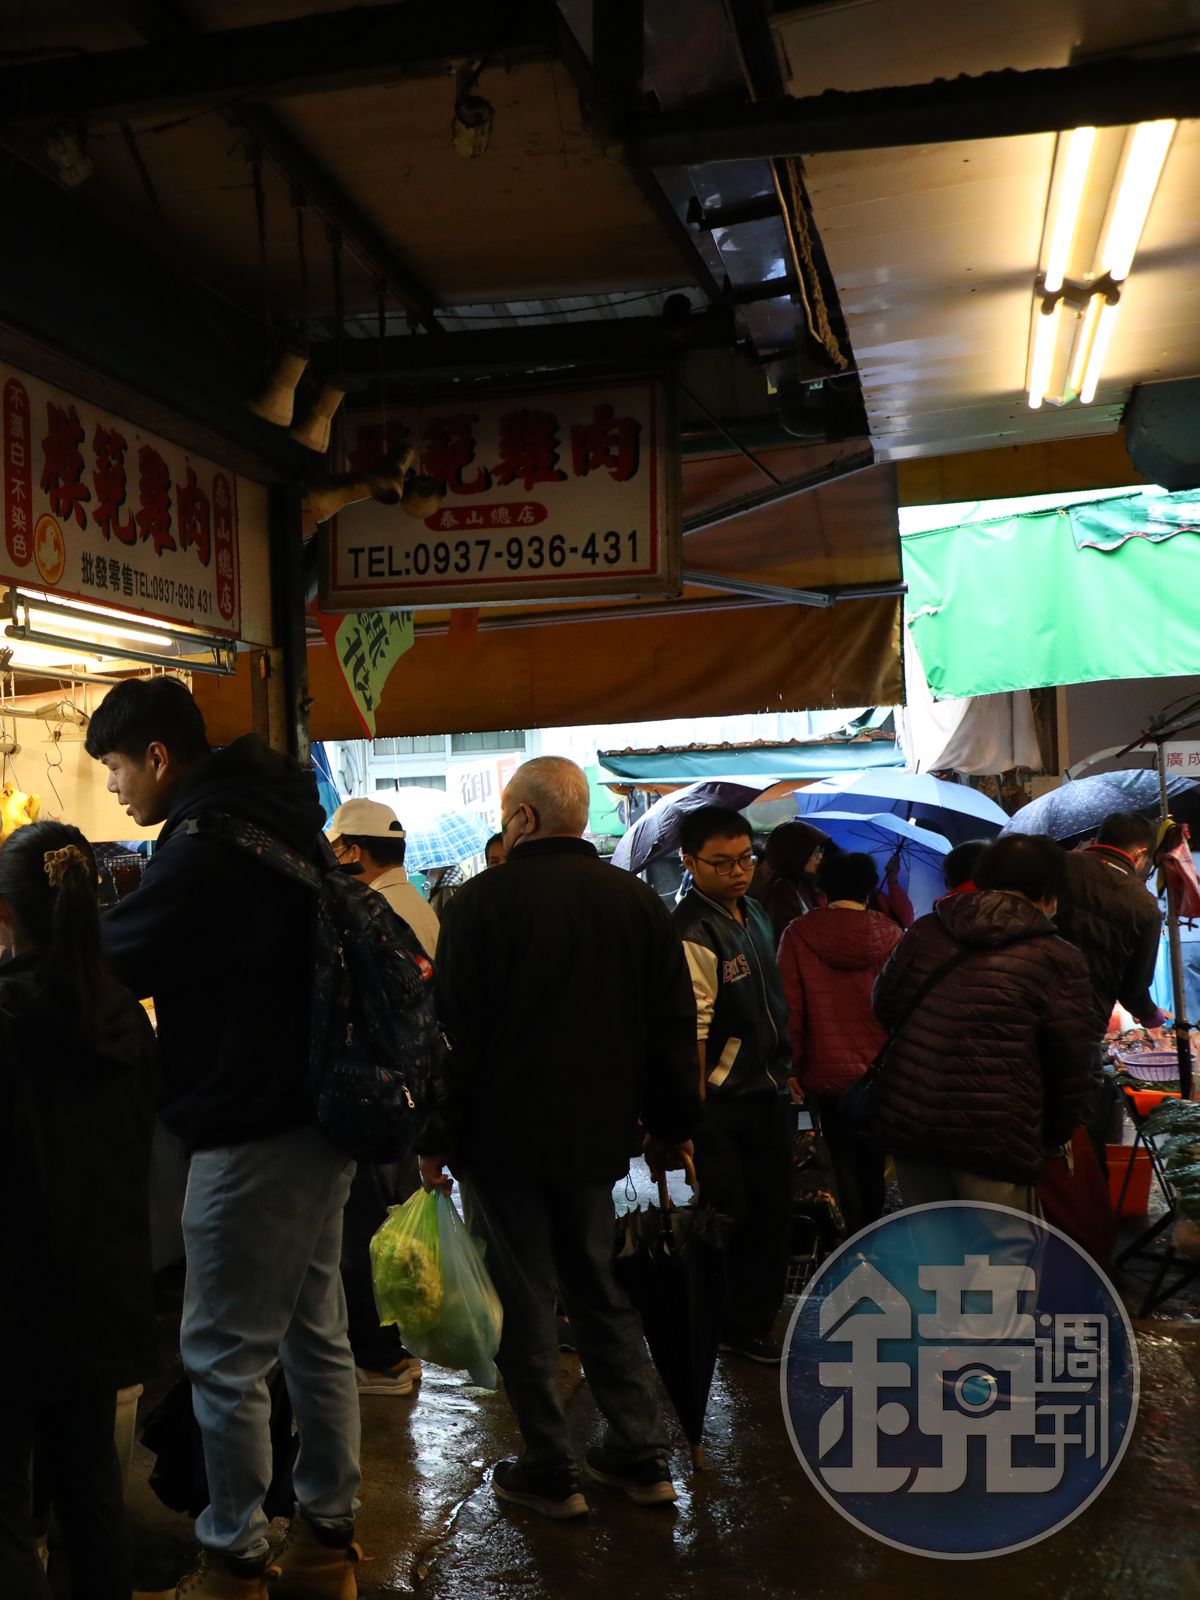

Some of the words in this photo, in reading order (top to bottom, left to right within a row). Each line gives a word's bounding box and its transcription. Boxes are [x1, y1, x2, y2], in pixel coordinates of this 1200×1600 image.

[438, 504, 537, 528] 泰山總店
[348, 530, 639, 579] TEL:0937-936-431
